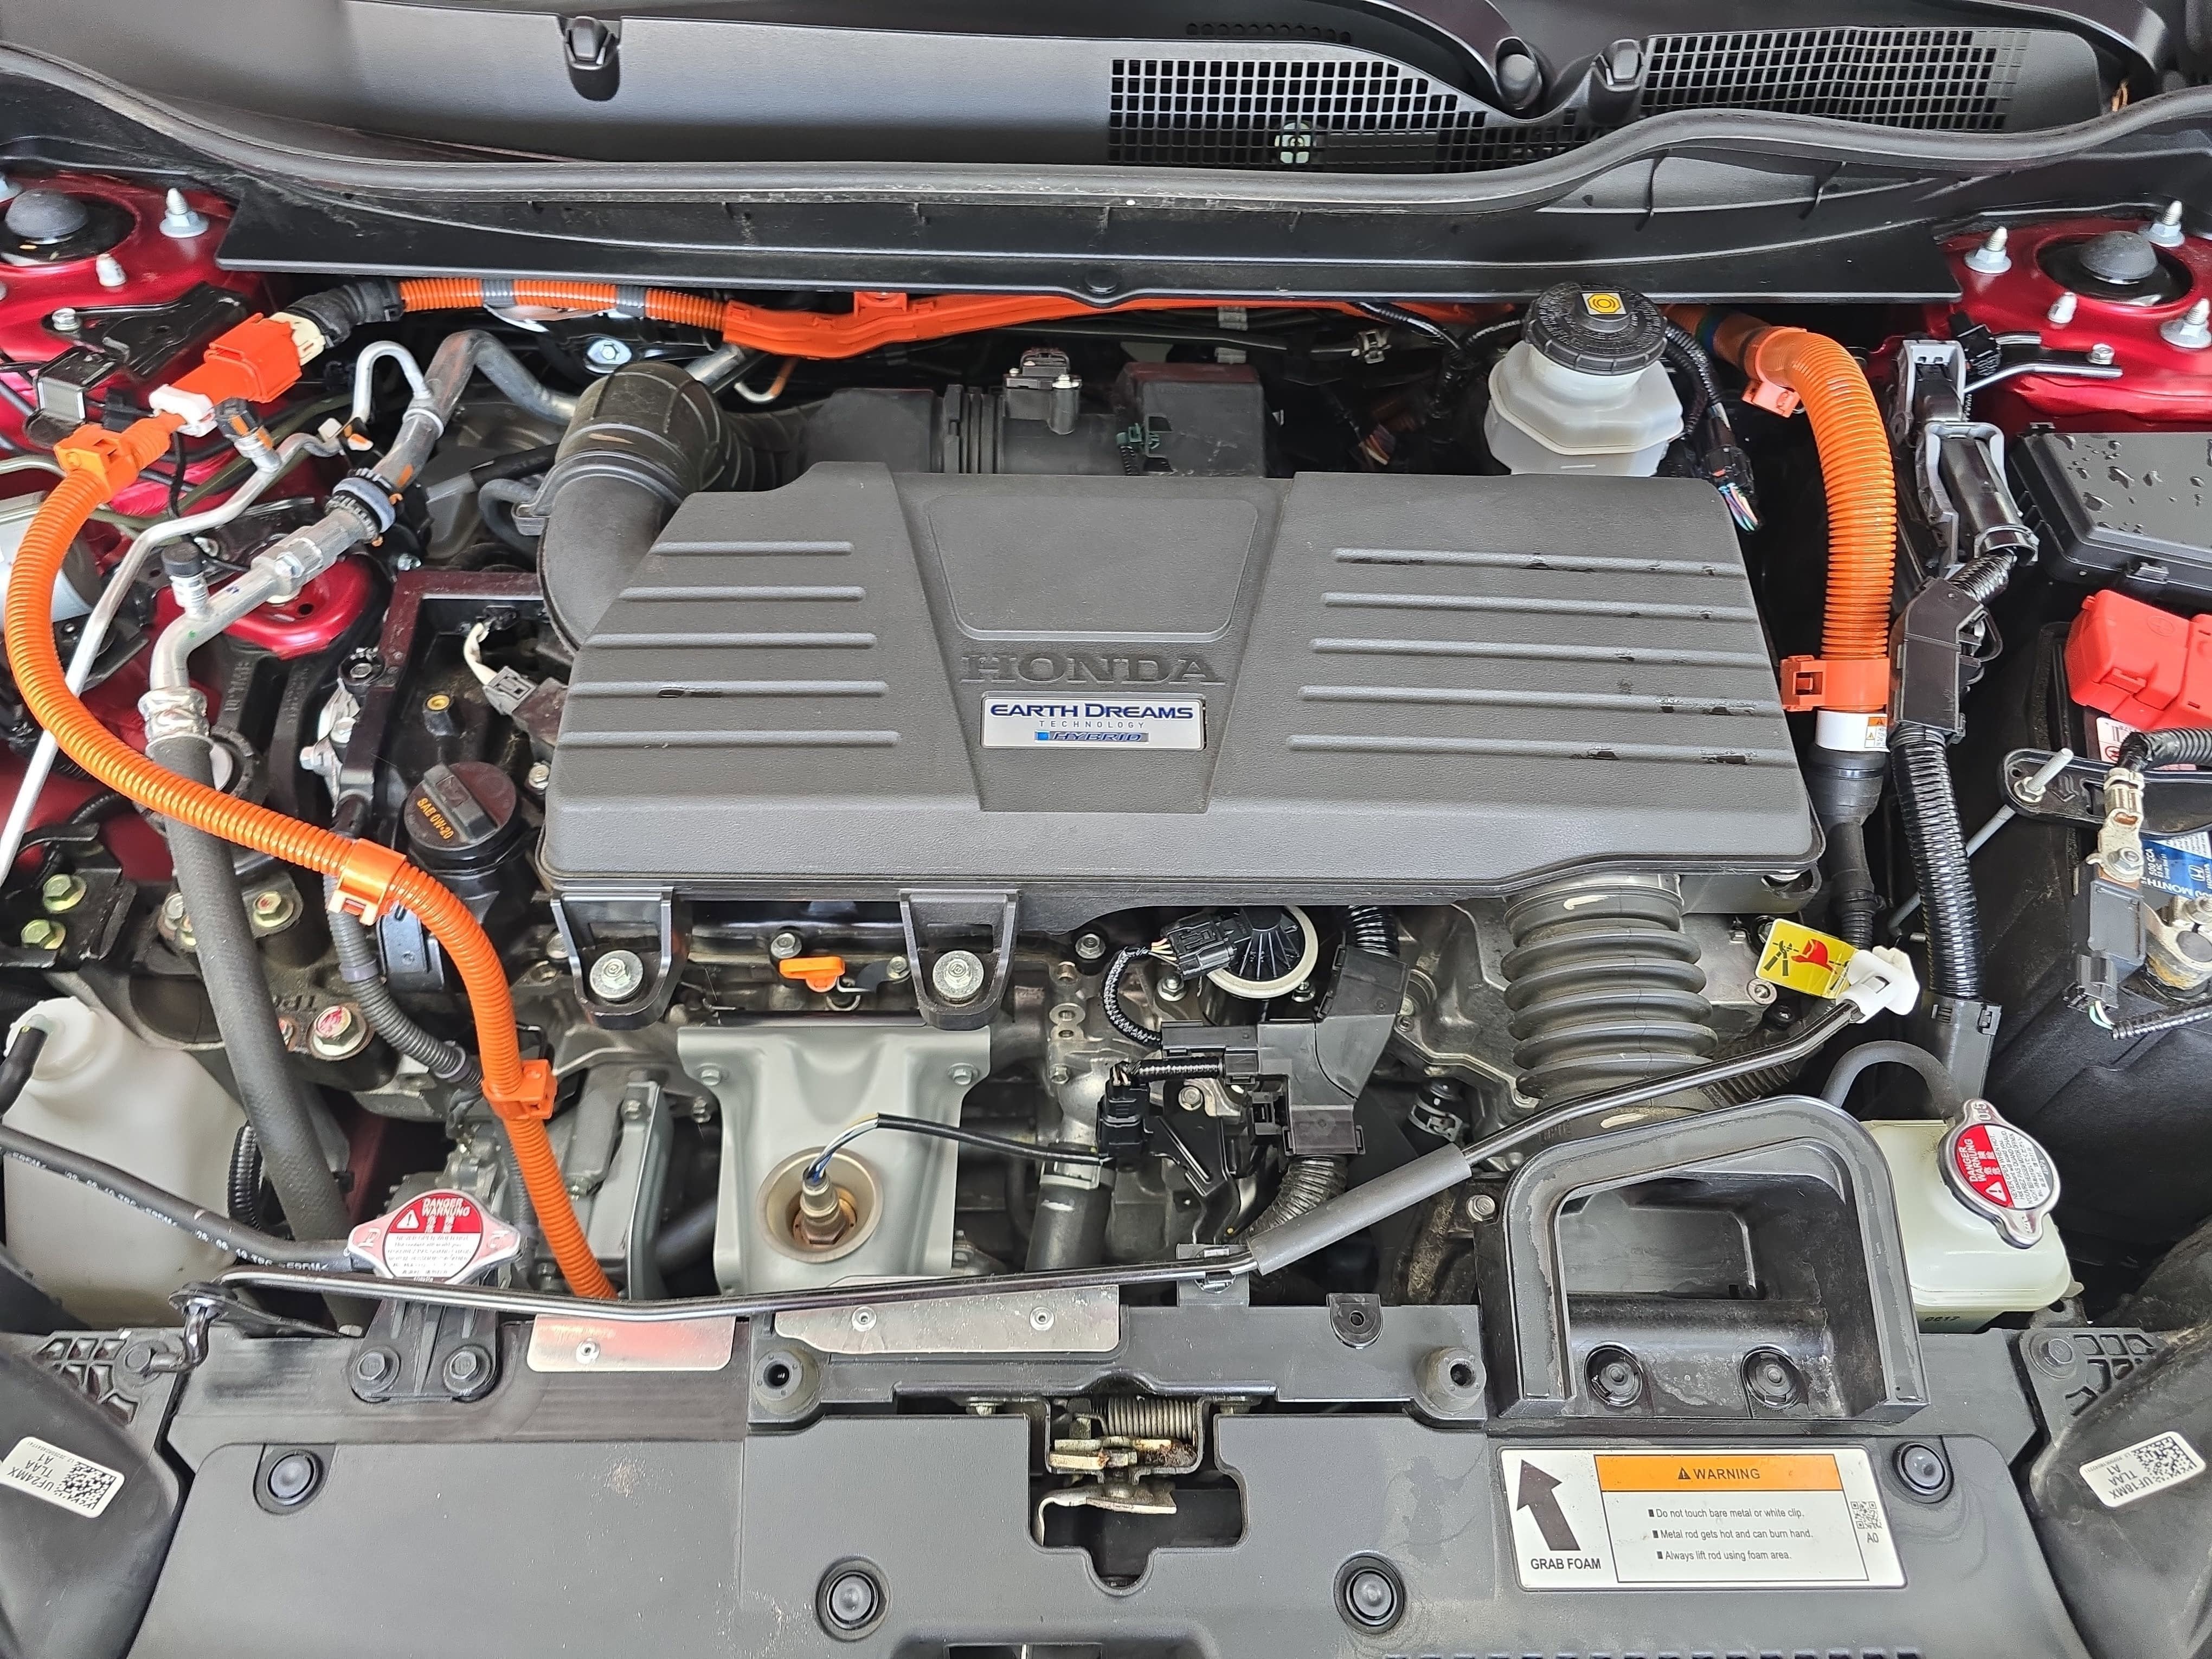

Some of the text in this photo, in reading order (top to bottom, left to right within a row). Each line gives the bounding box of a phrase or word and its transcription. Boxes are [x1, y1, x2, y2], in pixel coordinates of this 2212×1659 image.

[960, 654, 1226, 686] HONDA
[990, 704, 1194, 719] EARTH DREAMS
[1039, 720, 1145, 729] TECHNOLOGY
[1052, 732, 1142, 742] HYBRID
[416, 798, 436, 817] SAE
[2144, 848, 2157, 876] 500 CCA
[2147, 878, 2194, 896] MONTH
[1973, 1101, 1991, 1121] 0.5
[1964, 1138, 1986, 1182] WARNUNG
[1995, 1147, 2005, 1163] WHEN
[2007, 1148, 2019, 1167] QUAND
[1958, 1146, 1977, 1182] DANGER
[2002, 1165, 2010, 1180] OPEN
[2014, 1167, 2023, 1178] PAS
[2009, 1172, 2021, 1190] coolant
[2008, 1181, 2018, 1199] NEVER
[37, 1454, 54, 1464] A1
[25, 1459, 53, 1478] TLAA
[1693, 1468, 1760, 1480] WARNING
[2107, 1463, 2121, 1475] A1
[8, 1467, 55, 1491] UF24MX
[2108, 1470, 2137, 1486] TLAA
[2108, 1476, 2153, 1499] UF18MX
[1656, 1509, 1668, 1517] Do
[1670, 1509, 1683, 1517] not
[1685, 1509, 1707, 1517] touch
[1709, 1509, 1727, 1517] bare
[1730, 1508, 1752, 1517] metal
[1764, 1508, 1786, 1517] white
[1787, 1508, 1804, 1519] clip.
[1661, 1529, 1683, 1539] Metal
[1685, 1529, 1699, 1539] rod
[1701, 1530, 1718, 1541] gets
[1720, 1529, 1734, 1539] hot
[1735, 1529, 1751, 1539] and
[1769, 1529, 1789, 1538] burn
[1790, 1529, 1814, 1538] hand.
[1867, 1532, 1879, 1544] A0
[1531, 1558, 1602, 1570] GRAB FOAM
[1666, 1550, 1791, 1562] Always lift rod using foam area.
